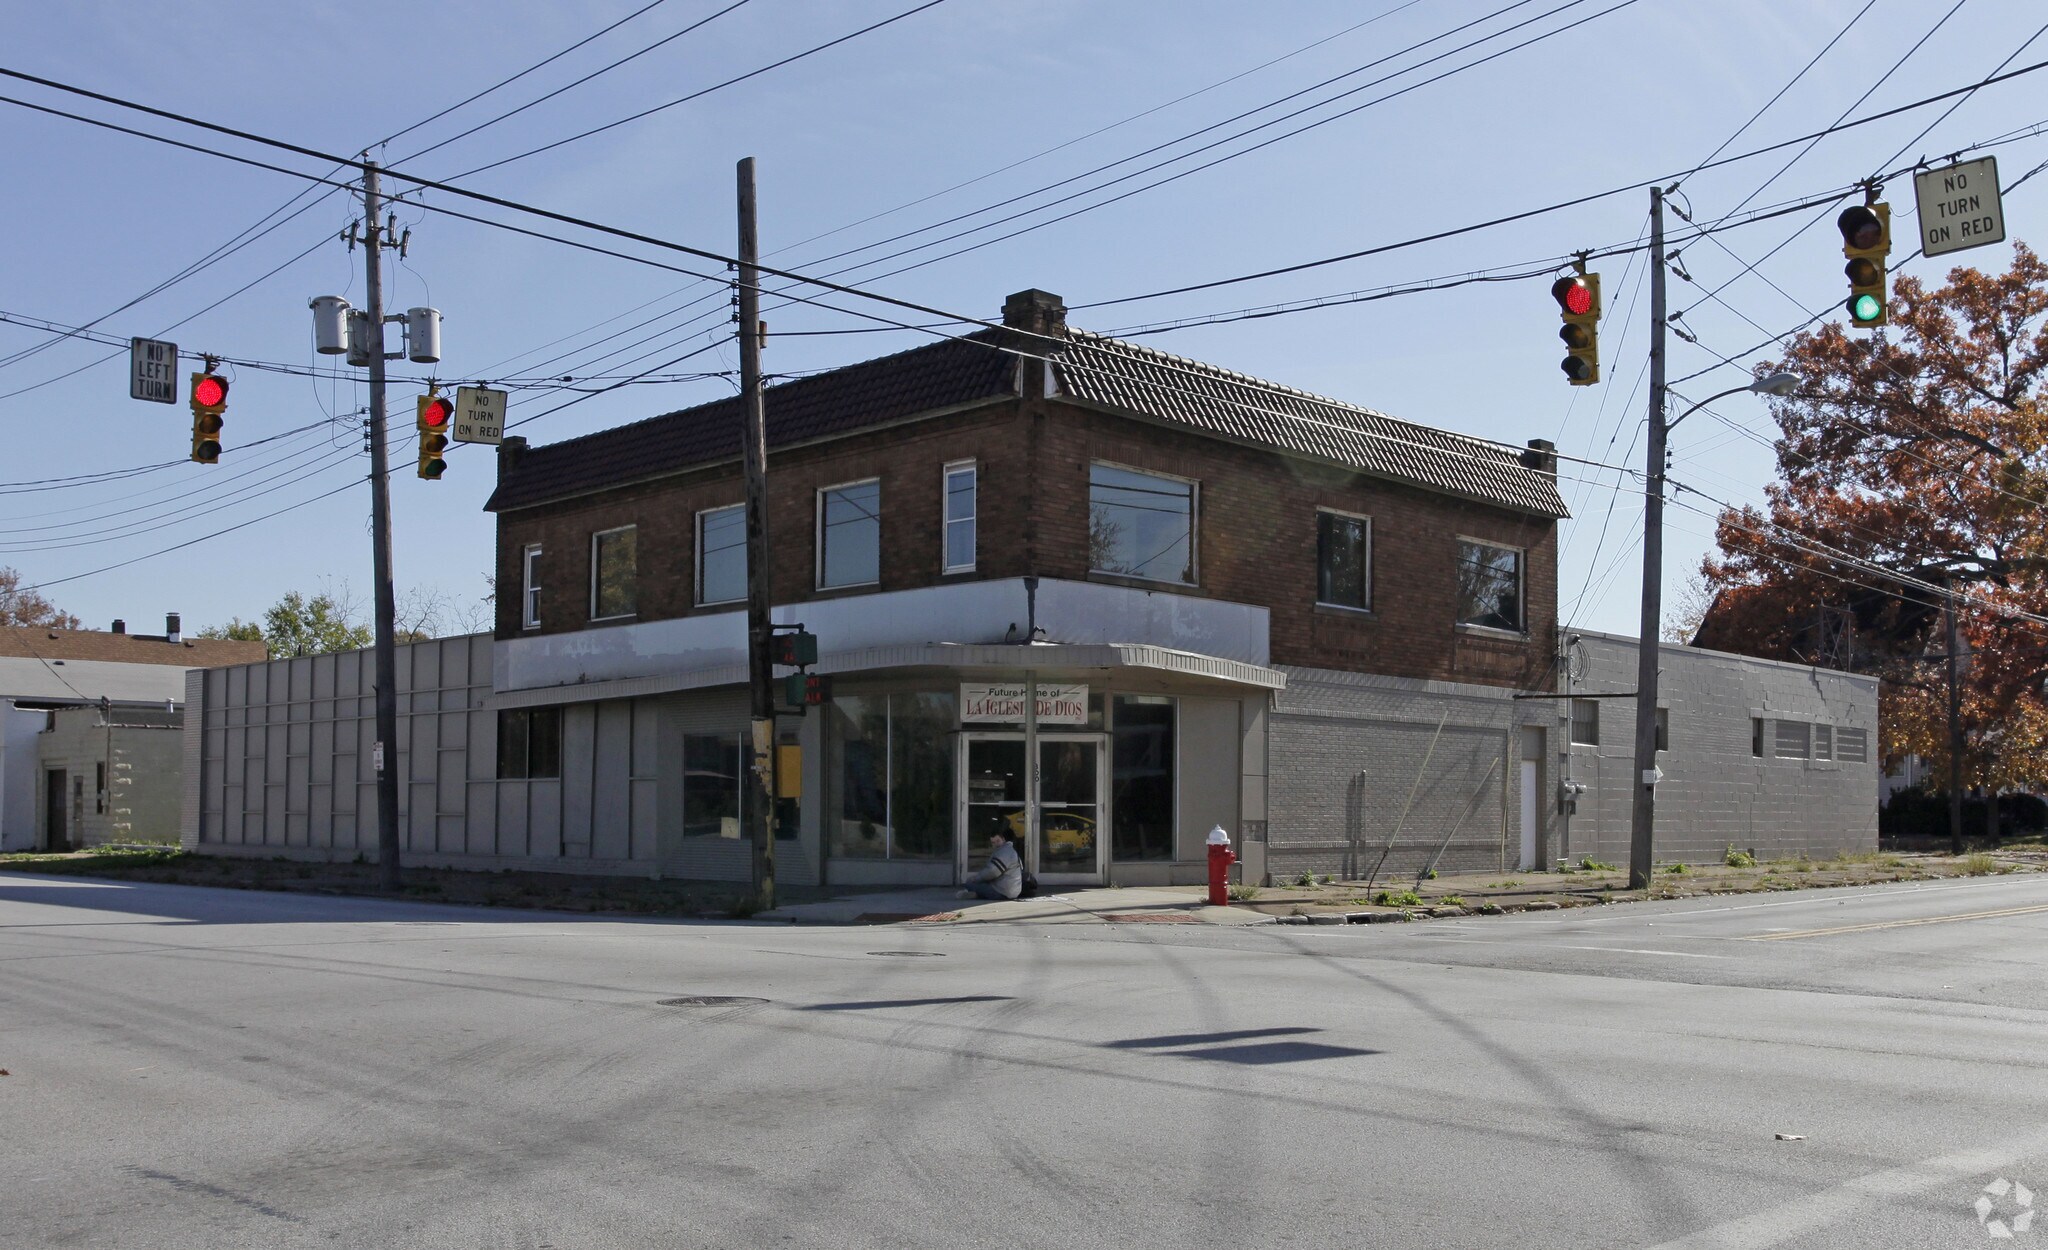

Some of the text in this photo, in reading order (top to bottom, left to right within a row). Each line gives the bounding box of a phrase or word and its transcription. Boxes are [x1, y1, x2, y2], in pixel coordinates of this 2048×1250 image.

[1944, 174, 1967, 193] NO
[1937, 195, 1980, 218] TURN
[1929, 216, 1994, 244] ON RED
[147, 343, 163, 362] NO
[138, 360, 171, 381] LEFT
[137, 379, 171, 399] TURN
[475, 395, 489, 406] NO
[468, 409, 494, 422] TURN
[458, 424, 499, 438] ON RED
[988, 688, 1060, 697] Future Hme of
[966, 699, 1082, 717] LA IGLESI DE DIOS
